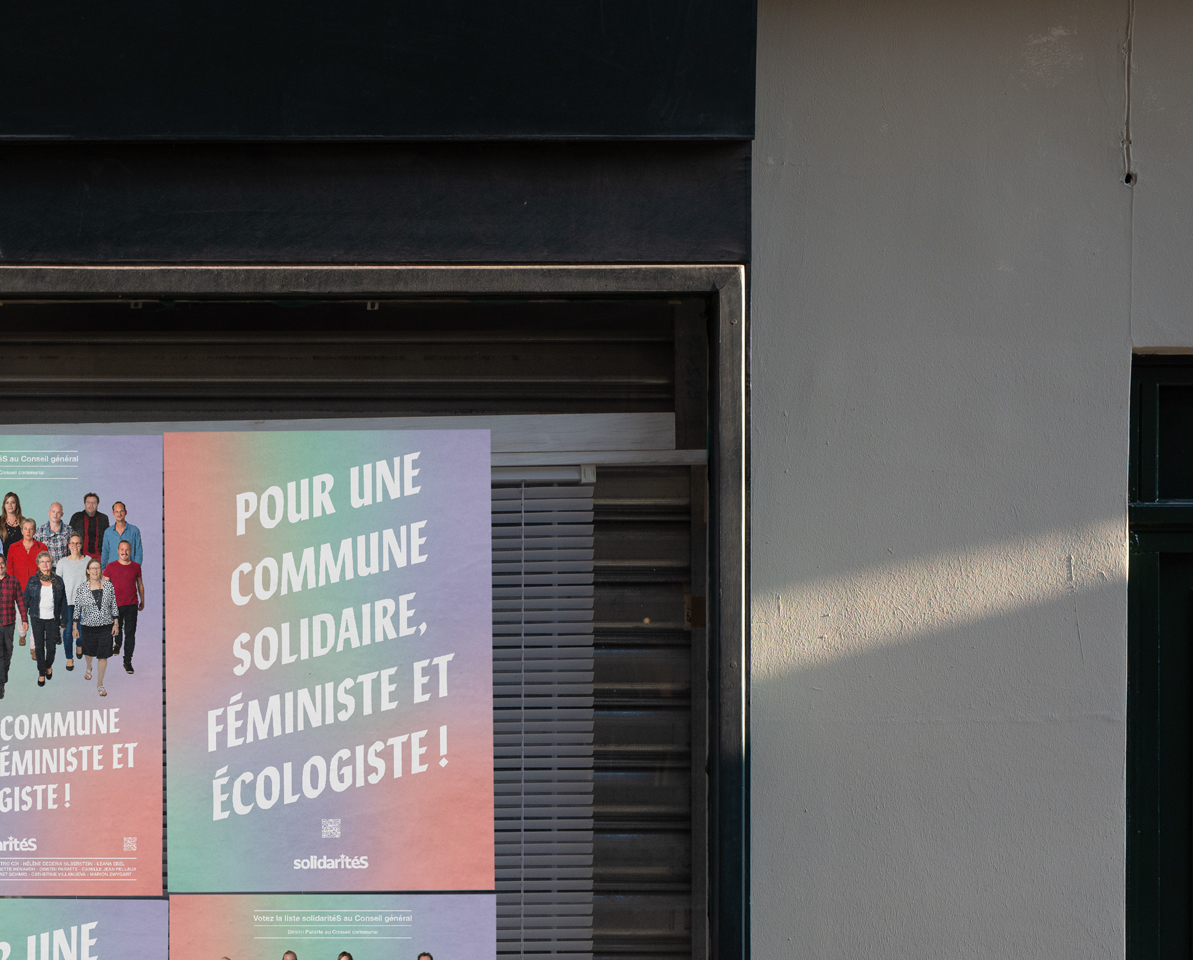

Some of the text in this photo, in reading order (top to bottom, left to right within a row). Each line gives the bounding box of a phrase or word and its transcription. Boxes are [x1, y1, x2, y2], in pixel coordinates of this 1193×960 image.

[236, 451, 422, 536] POUR UNE
[231, 520, 428, 606] COMMUNE
[233, 592, 427, 676] SOLIDAIRE,
[0, 708, 120, 741] COMMUNE
[208, 653, 455, 753] FÉMINISTE ET
[64, 783, 70, 808] !
[112, 742, 138, 769] ET
[212, 725, 449, 821] ÉCOLOGISTE !
